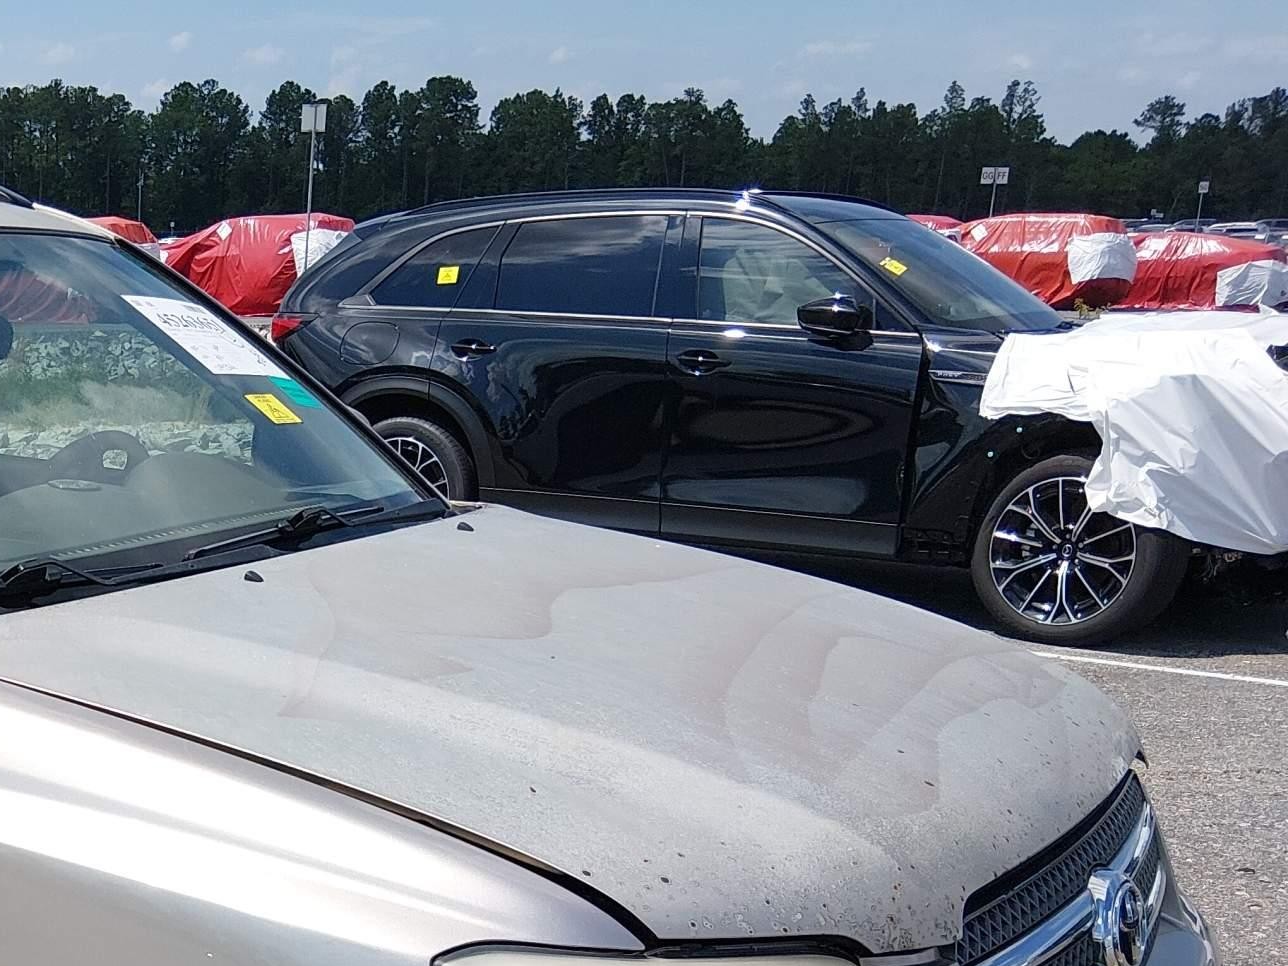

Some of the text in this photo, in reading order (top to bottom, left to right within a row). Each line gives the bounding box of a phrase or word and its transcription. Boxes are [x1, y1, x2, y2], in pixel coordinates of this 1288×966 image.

[982, 171, 993, 180] GG
[997, 171, 1008, 180] FF
[156, 313, 226, 334] 45263651
